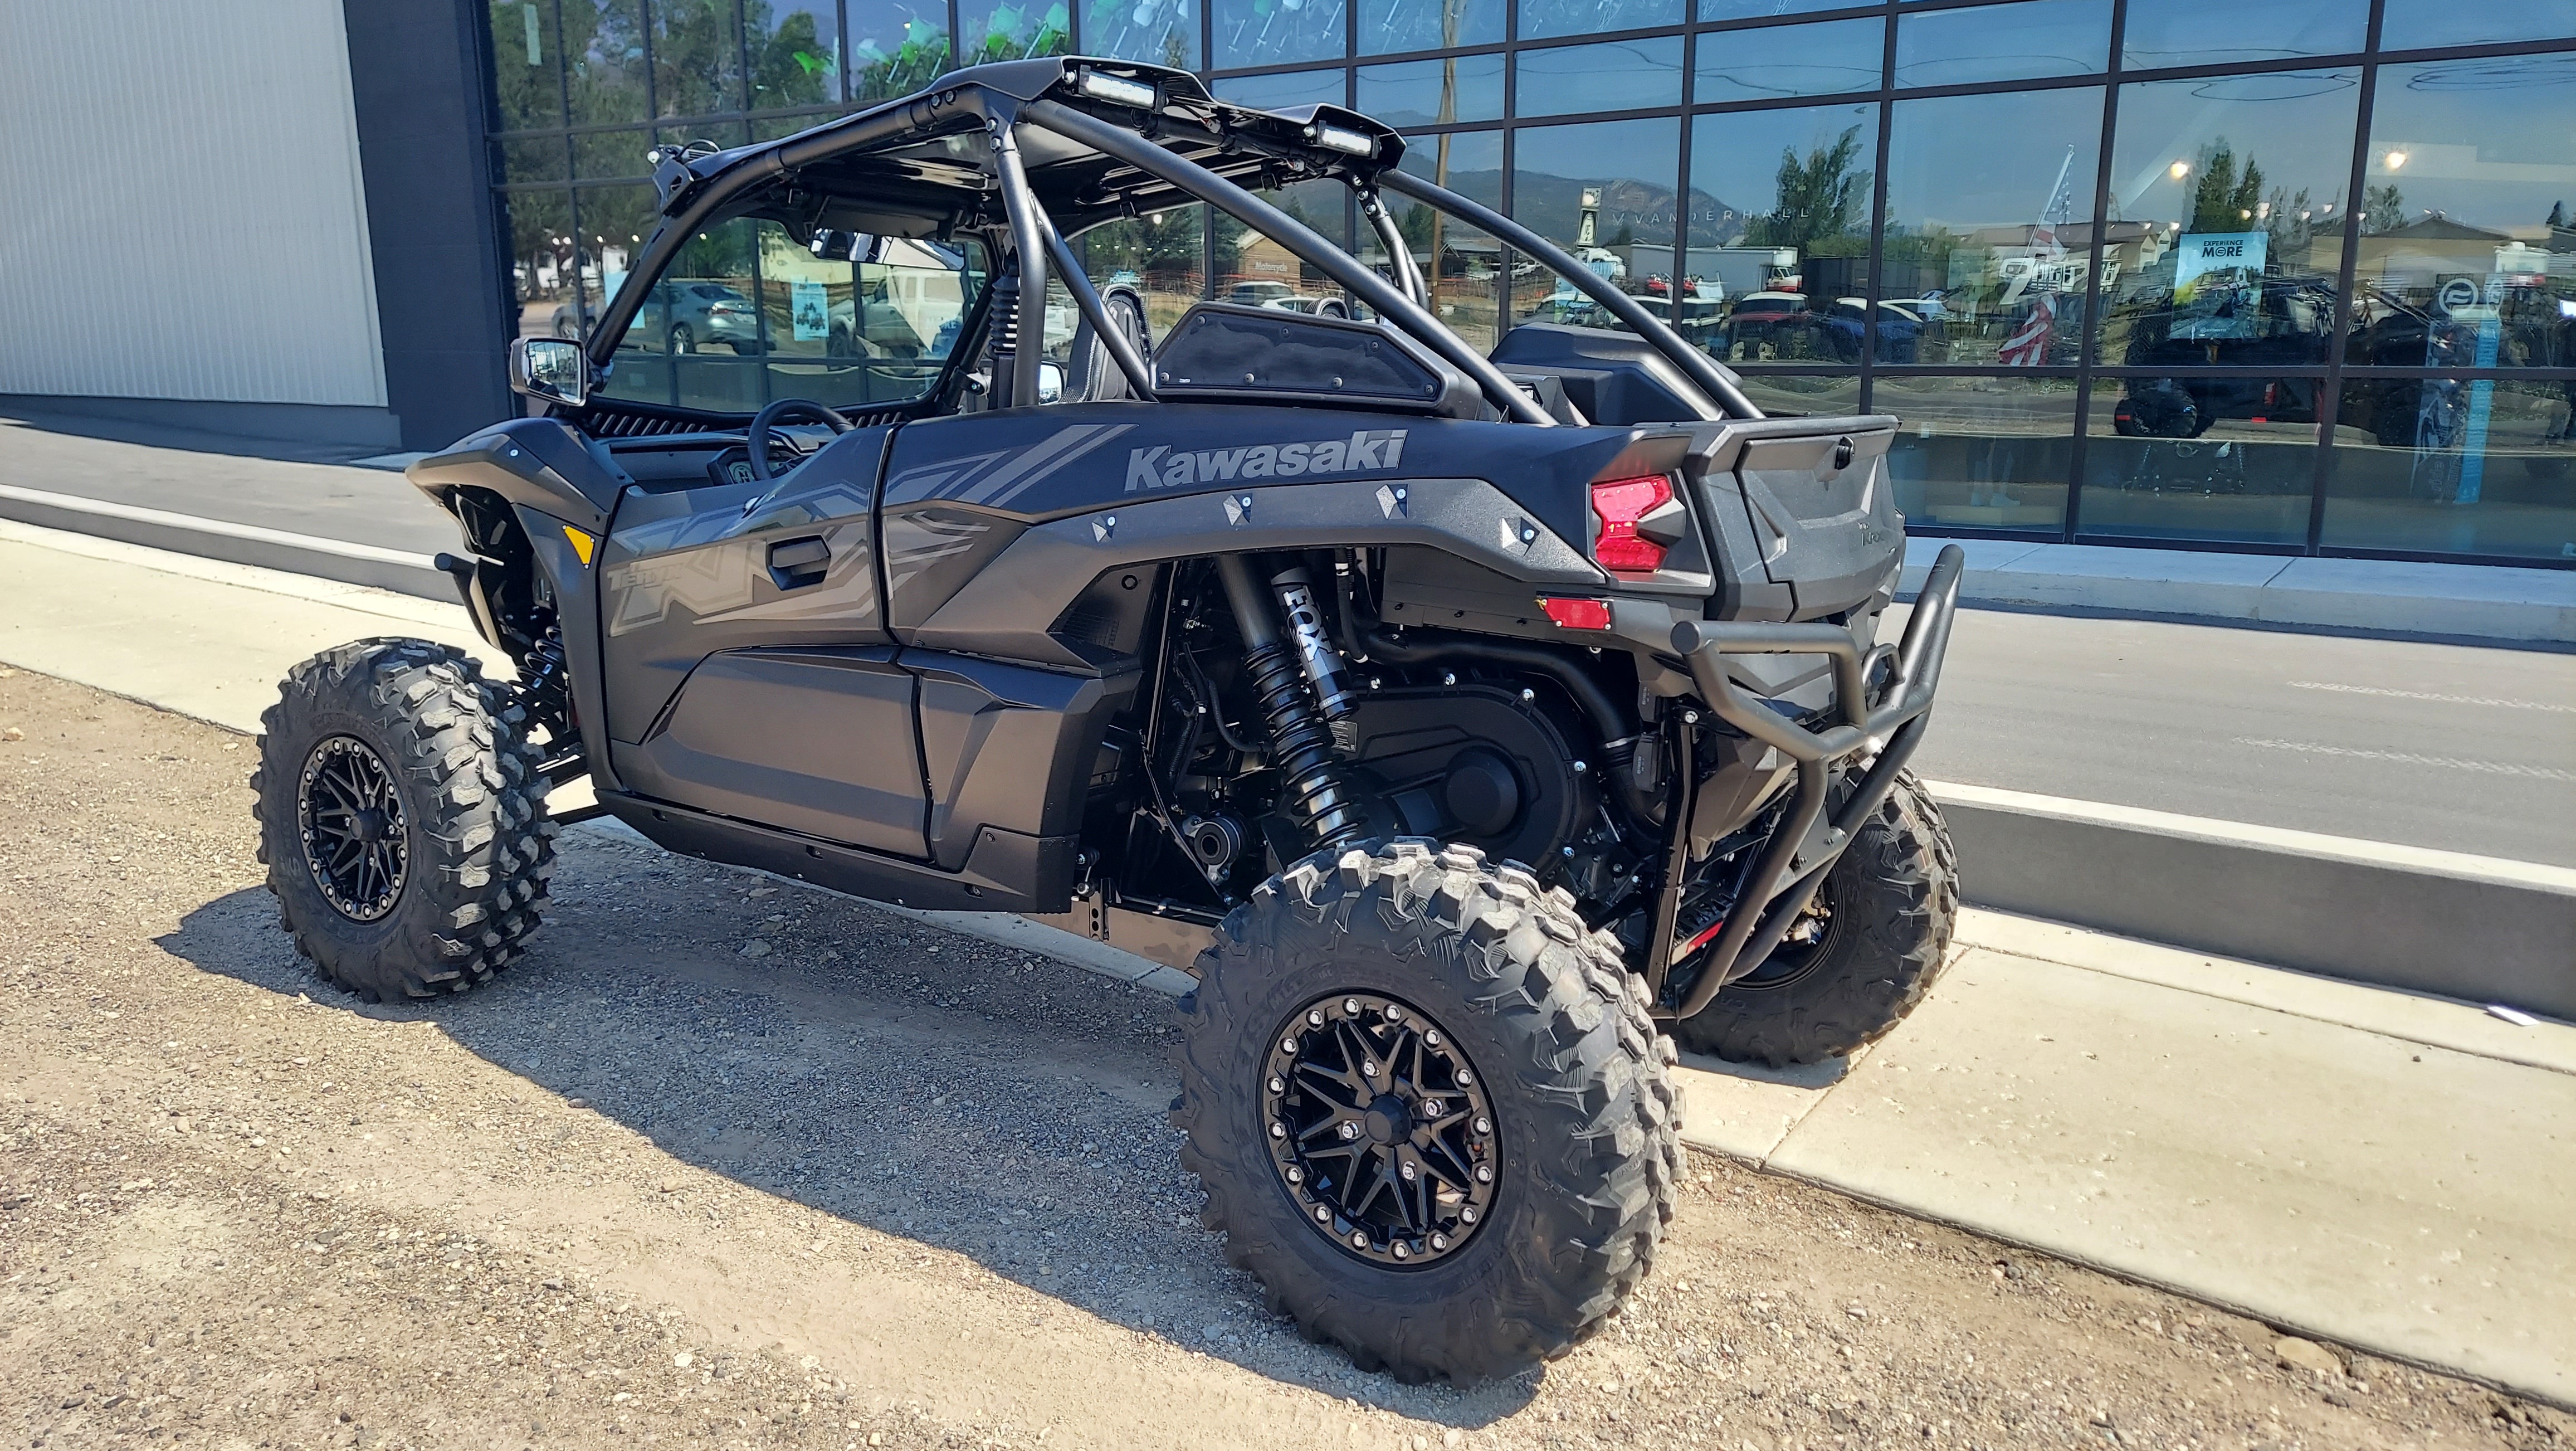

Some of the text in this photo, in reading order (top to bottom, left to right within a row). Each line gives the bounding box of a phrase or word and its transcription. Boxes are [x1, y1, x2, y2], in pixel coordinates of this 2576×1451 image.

[2202, 246, 2243, 257] MORE
[1124, 429, 1409, 492] Kawasaki
[1283, 585, 1334, 663] FOX
